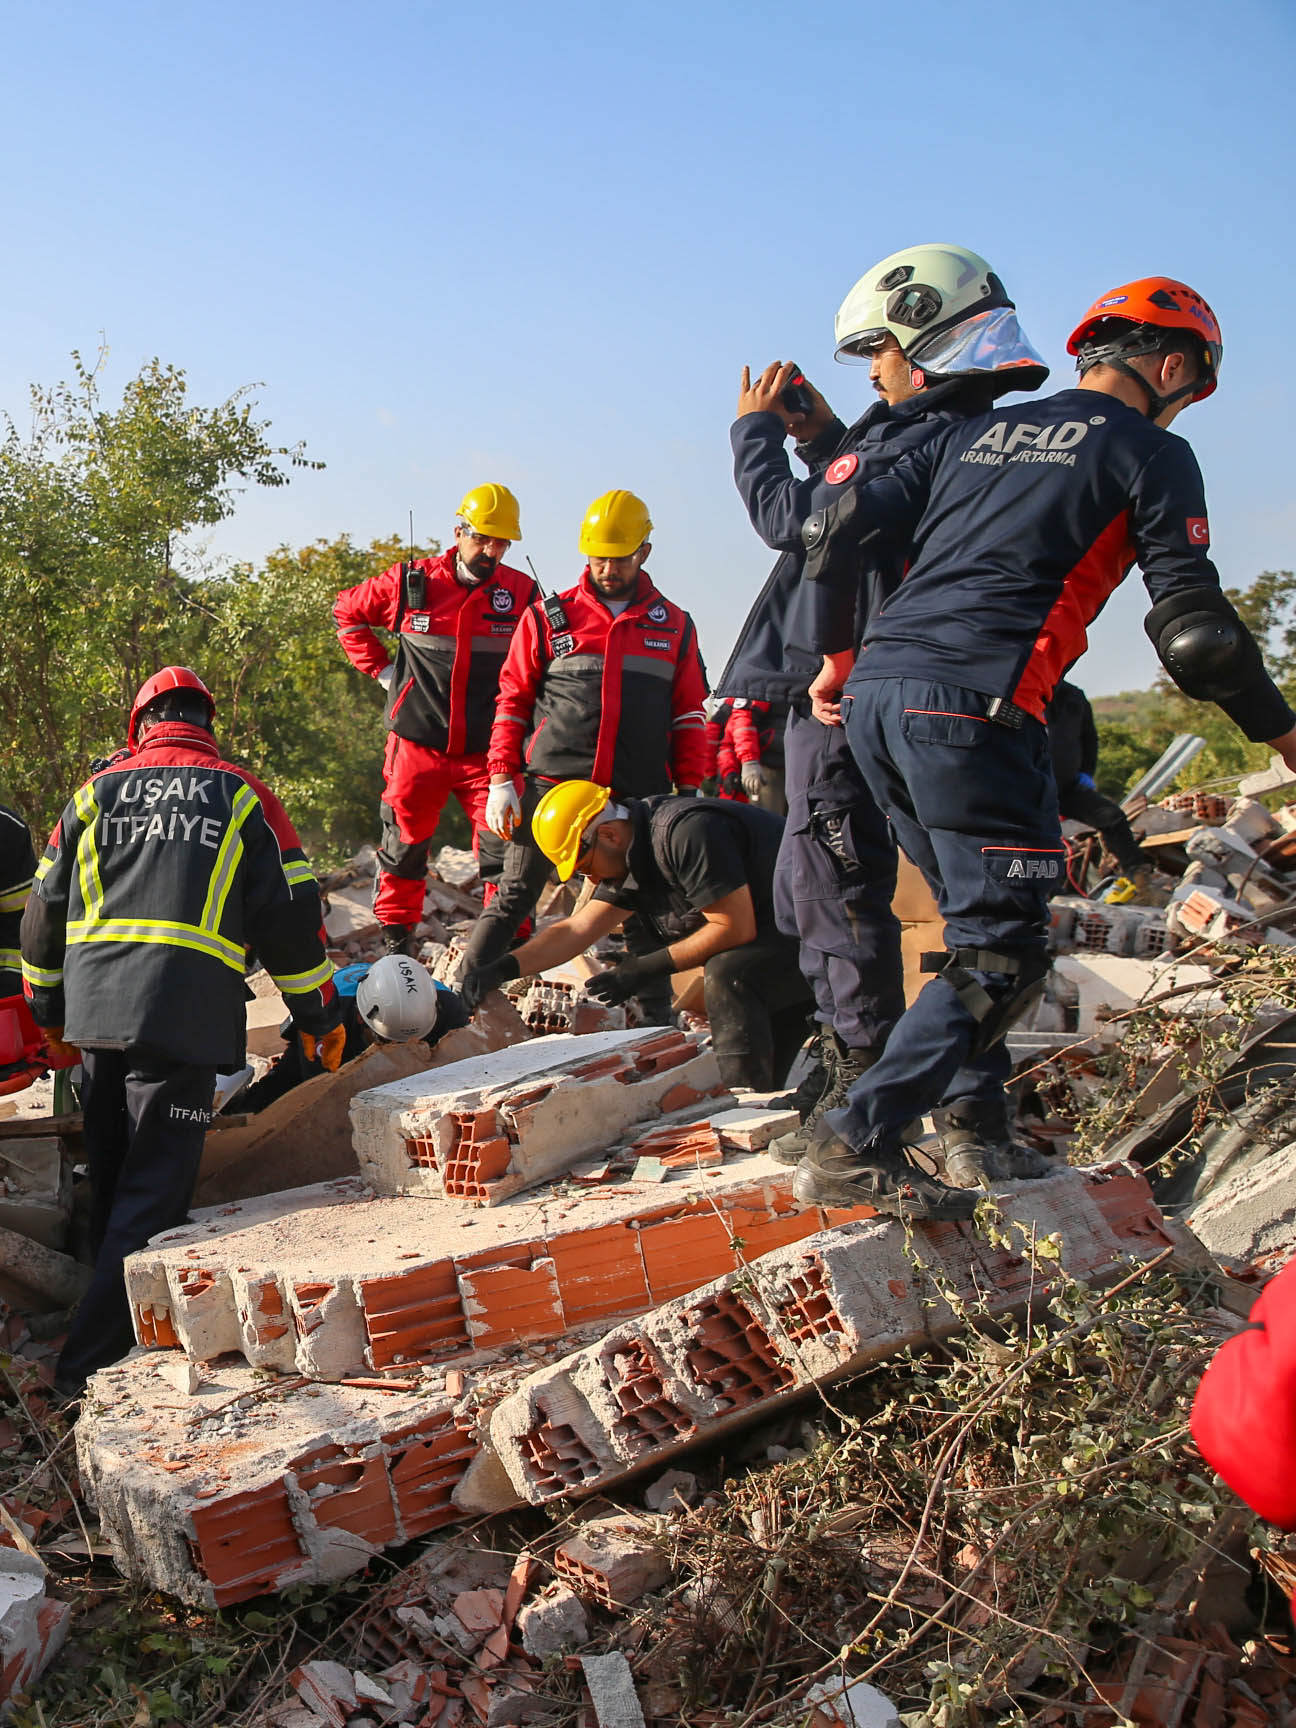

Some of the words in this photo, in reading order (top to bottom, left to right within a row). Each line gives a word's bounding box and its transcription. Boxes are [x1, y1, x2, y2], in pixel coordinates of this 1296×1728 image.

[970, 421, 1089, 453] AFAD
[120, 777, 214, 809] UŞAK
[101, 806, 223, 850] İTFAİYE
[1006, 859, 1060, 879] AFAD
[169, 1103, 211, 1123] İTFAİYE
